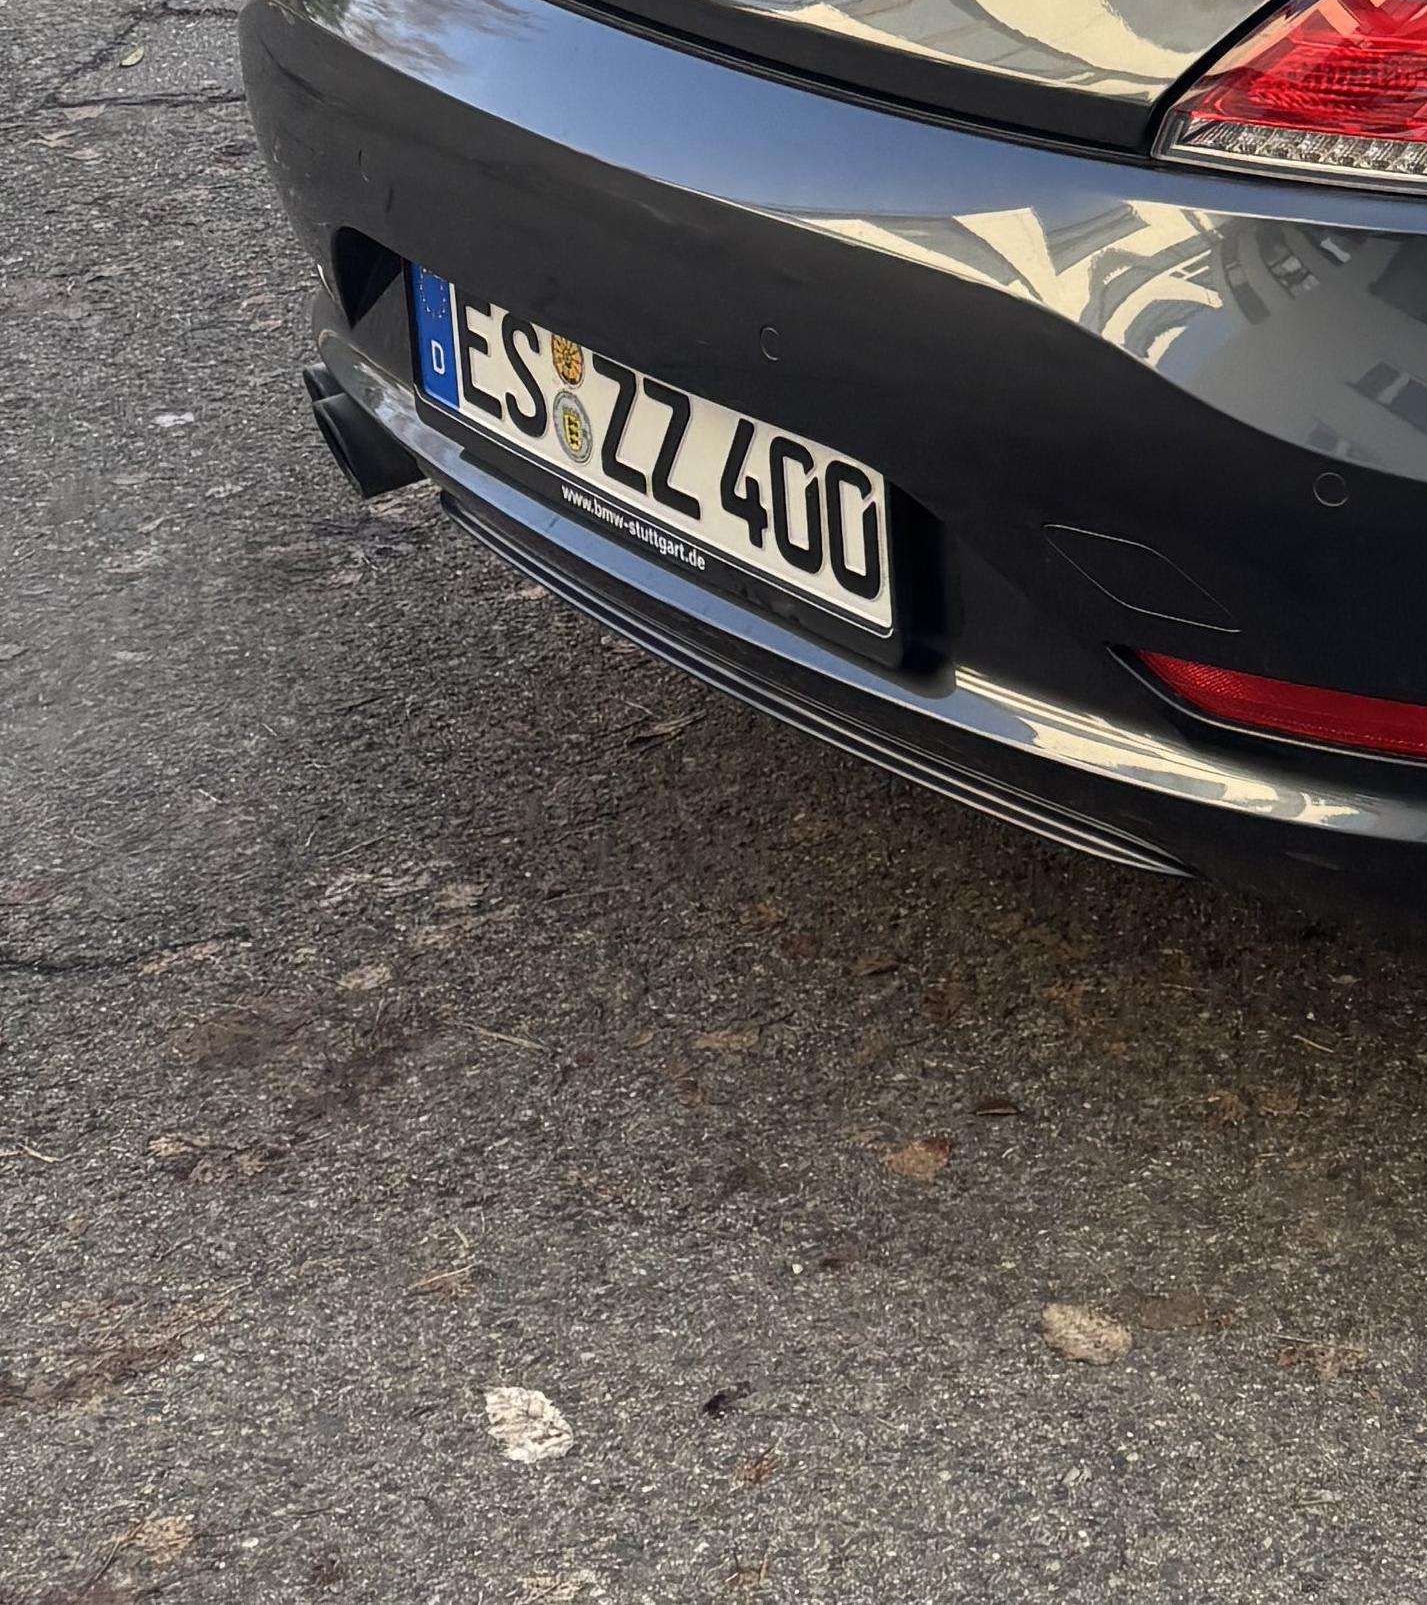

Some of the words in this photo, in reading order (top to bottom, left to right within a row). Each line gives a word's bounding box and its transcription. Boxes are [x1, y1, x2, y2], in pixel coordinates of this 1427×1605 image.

[431, 339, 446, 375] D
[459, 300, 548, 438] ES
[591, 352, 701, 521] ZZ
[719, 417, 881, 600] 400
[561, 484, 706, 571] www.bmw-stuttgart.de
